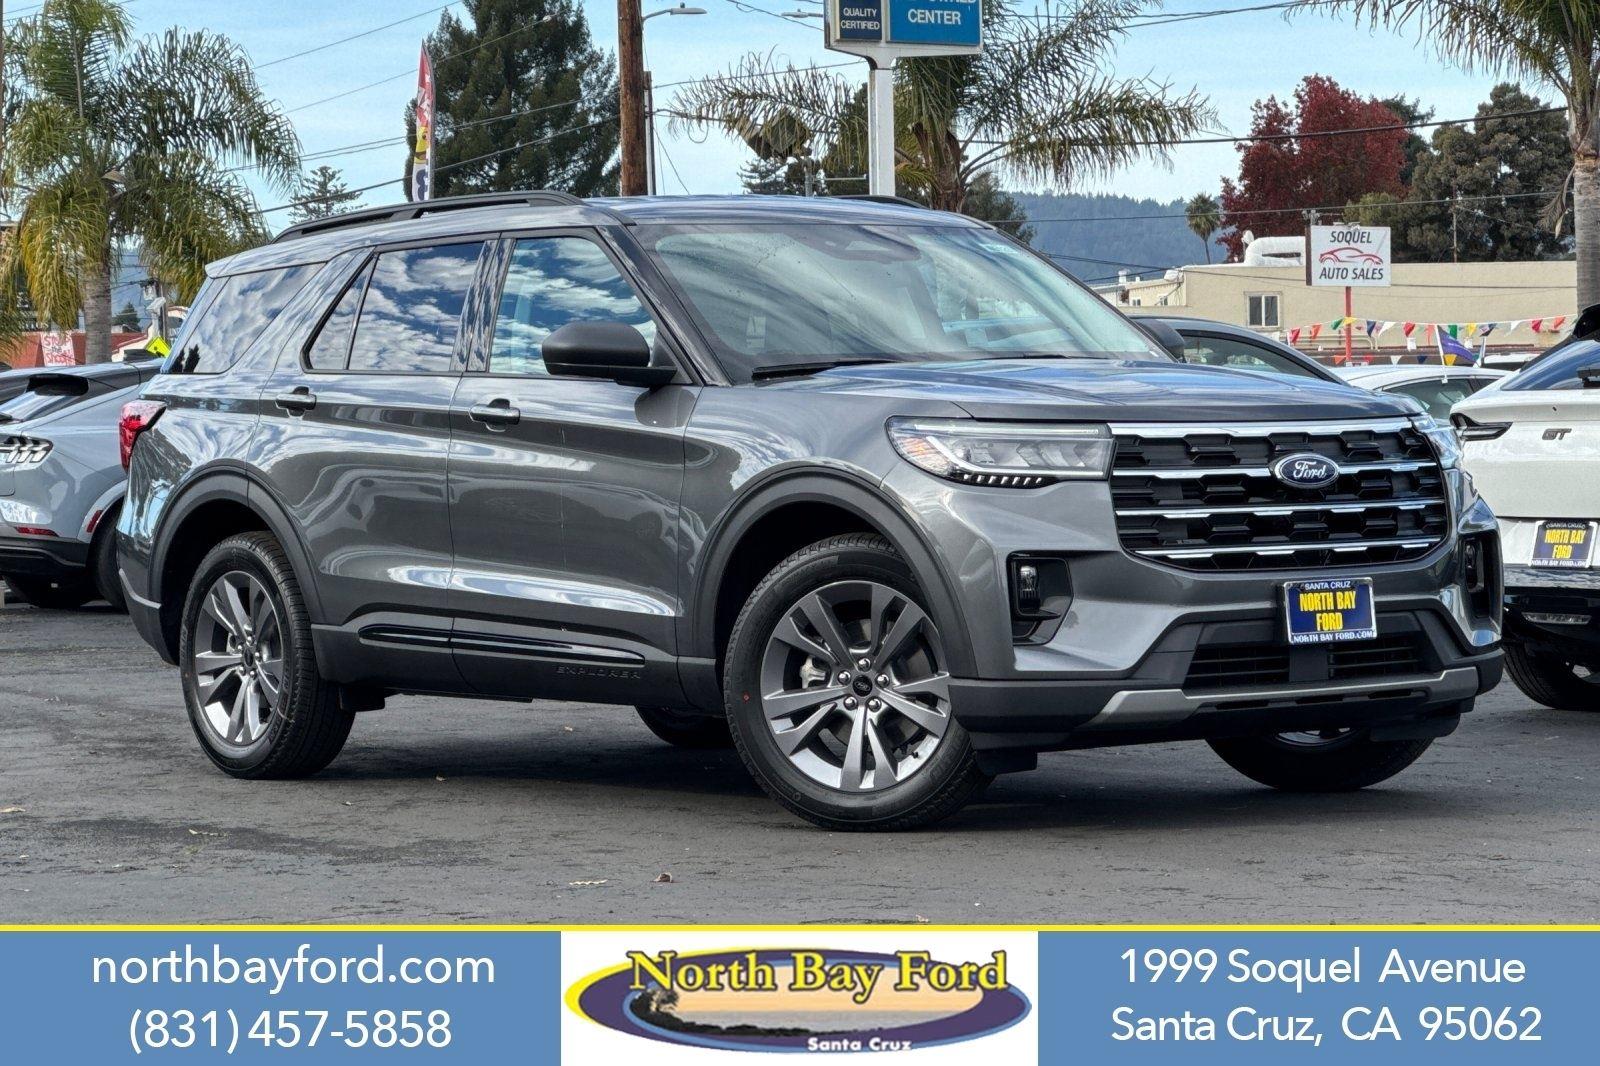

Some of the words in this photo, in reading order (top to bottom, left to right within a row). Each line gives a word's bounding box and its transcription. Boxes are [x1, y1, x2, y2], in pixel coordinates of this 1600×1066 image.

[843, 8, 877, 17] QUALITY
[907, 9, 961, 25] CENTER
[840, 20, 881, 30] CERTIFIED
[1329, 230, 1372, 245] SOQUEL
[1319, 267, 1349, 279] AUTO
[1351, 268, 1383, 280] SALES
[1542, 428, 1572, 440] GT
[1292, 460, 1327, 480] Ford
[1544, 530, 1570, 543] NORTH
[1570, 530, 1586, 544] BAY
[1552, 545, 1573, 559] FORD
[1330, 581, 1351, 589] CRUZ
[1300, 592, 1335, 612] NORTH
[1336, 590, 1356, 609] BAY
[1316, 612, 1343, 631] FORD
[1293, 634, 1319, 643] NORTH
[1319, 633, 1334, 642] BAY
[1335, 631, 1373, 640] FORD.COM
